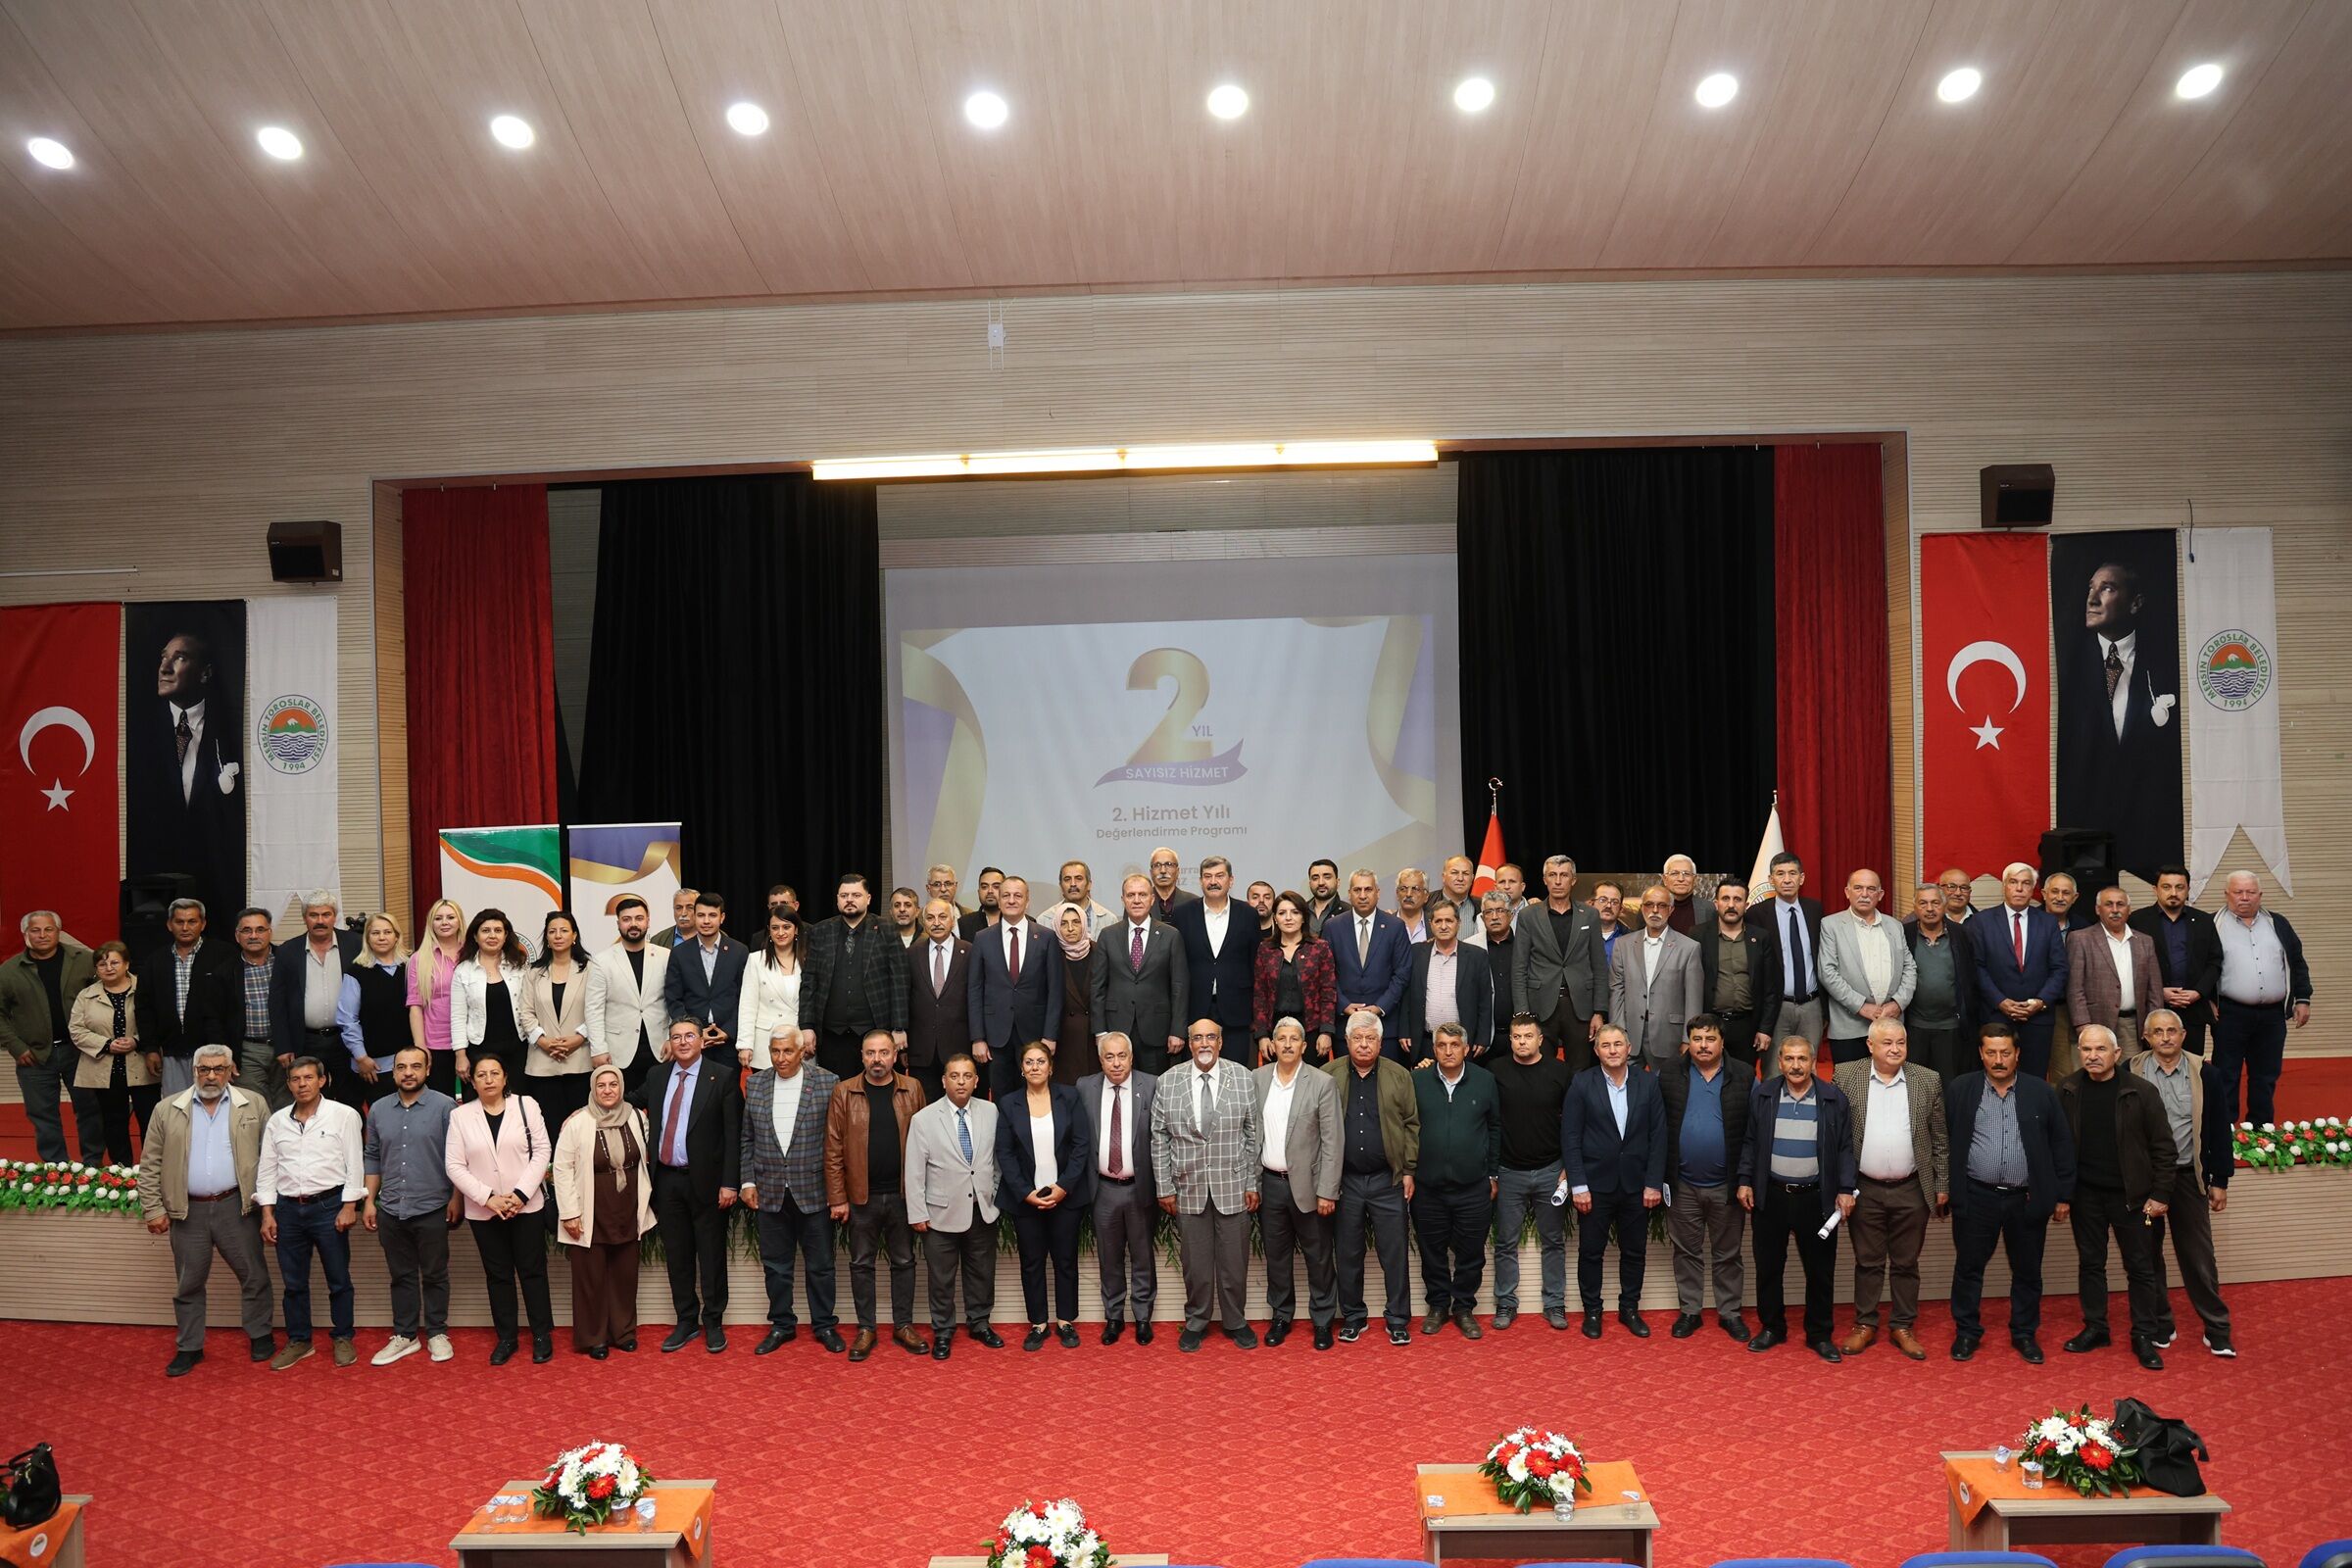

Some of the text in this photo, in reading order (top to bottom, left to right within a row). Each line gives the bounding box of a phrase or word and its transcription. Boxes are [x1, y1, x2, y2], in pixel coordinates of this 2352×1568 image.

[2203, 633, 2250, 658] TOROSLAR
[265, 699, 311, 720] TOROSLAR
[1126, 647, 1214, 764] 2
[1192, 725, 1213, 737] YIL
[282, 762, 306, 771] 1994
[1125, 764, 1229, 779] SAYISIZ HİZMET
[1112, 805, 1230, 822] 2. Hizmet Yılı
[1097, 826, 1248, 841] Değerlendirme Programı
